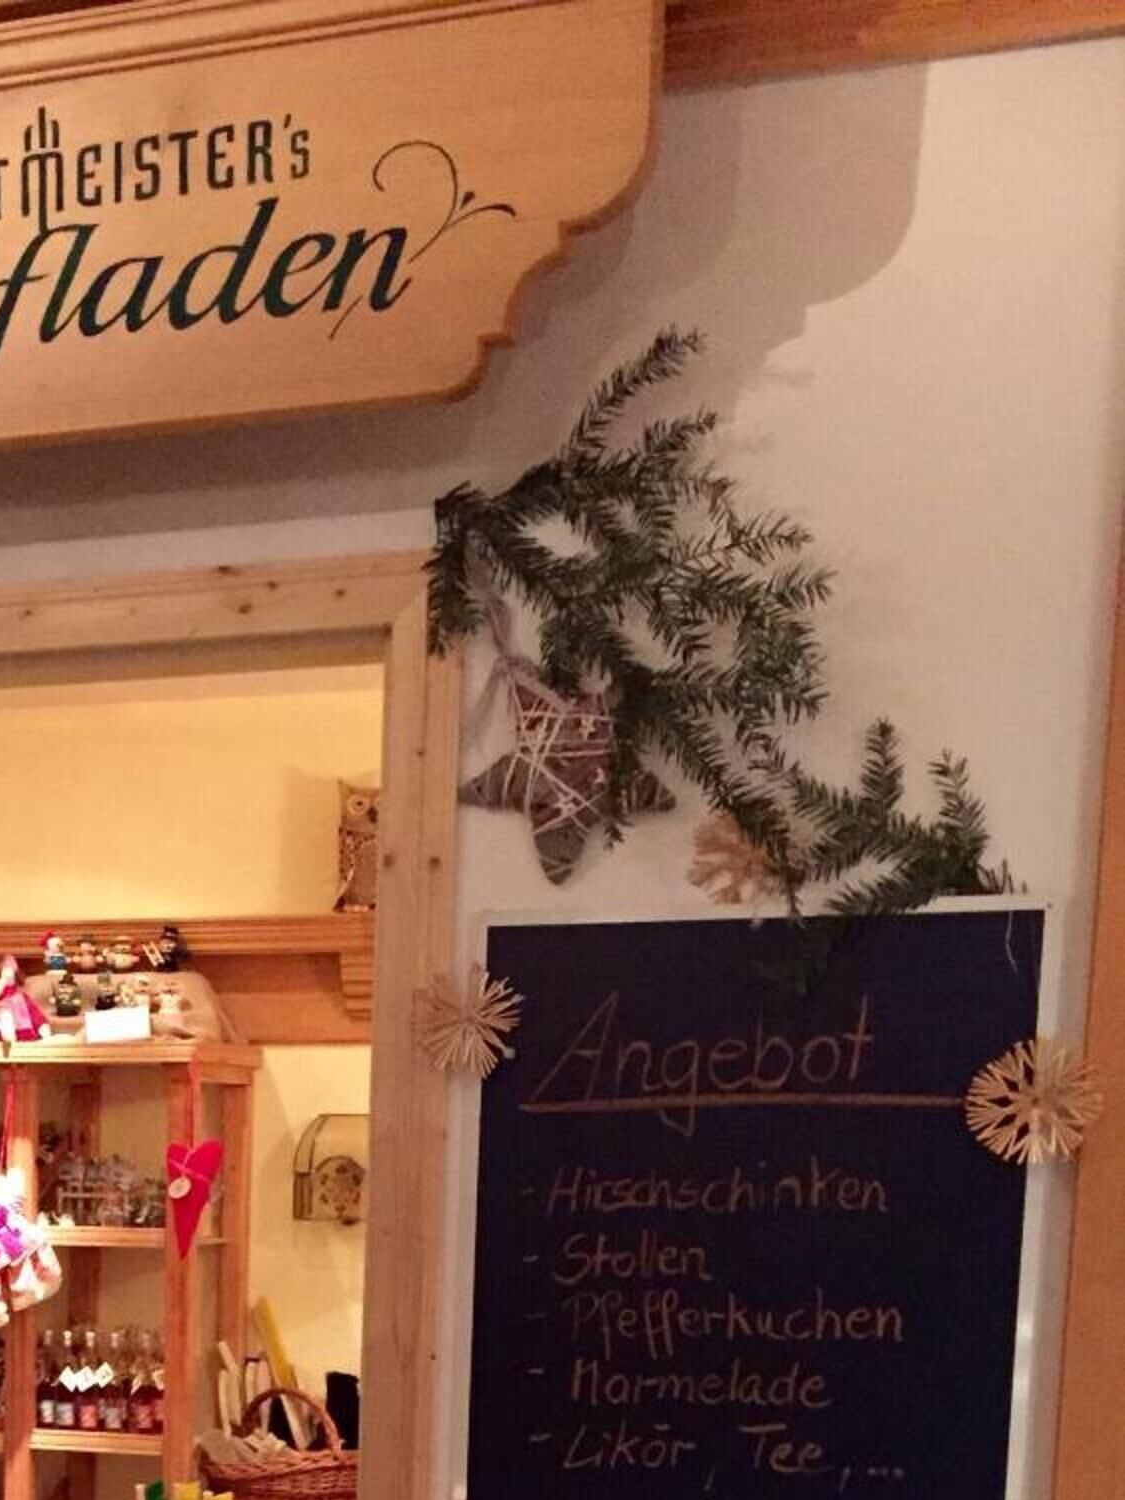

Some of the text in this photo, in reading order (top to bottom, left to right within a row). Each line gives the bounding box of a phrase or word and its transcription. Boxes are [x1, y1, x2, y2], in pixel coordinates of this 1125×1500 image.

[529, 990, 874, 1136] Angebot
[553, 1229, 713, 1285] Stollen
[562, 1285, 904, 1360] Pfefferkuchen
[571, 1357, 833, 1407] Marmelade
